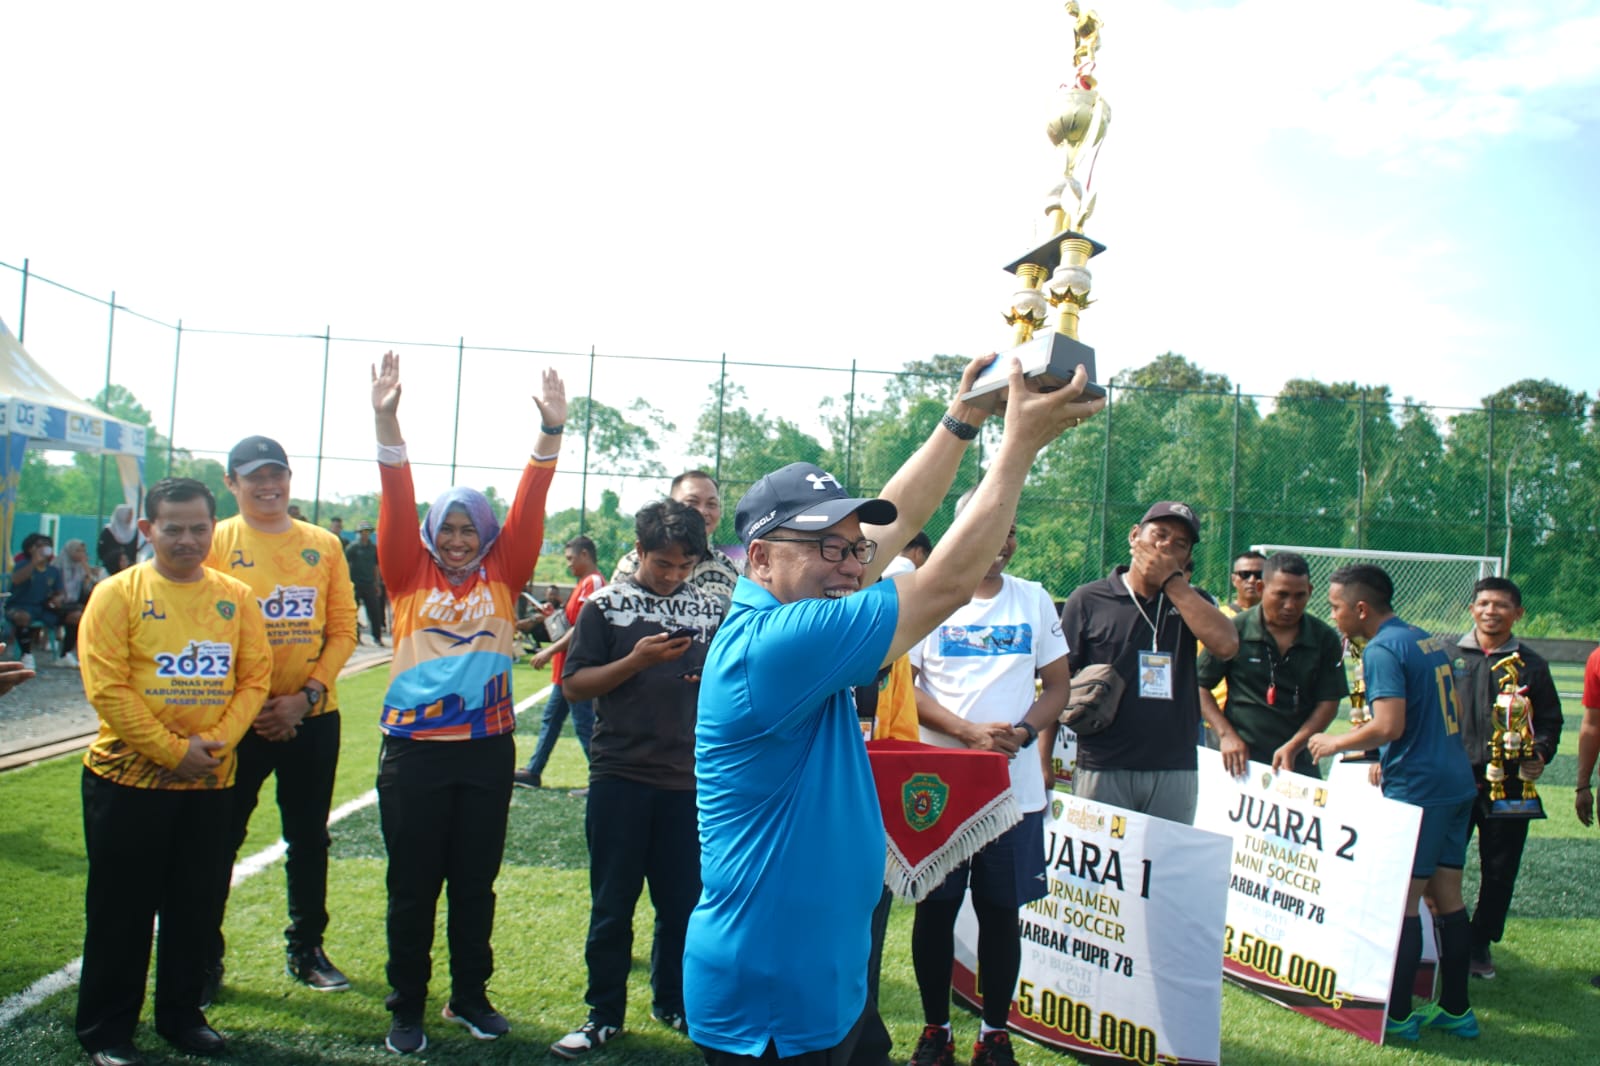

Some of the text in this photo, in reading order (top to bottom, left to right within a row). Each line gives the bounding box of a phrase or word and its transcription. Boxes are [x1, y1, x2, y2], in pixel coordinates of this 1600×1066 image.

[156, 654, 231, 677] 2023
[145, 688, 205, 696] KABUPATEN
[1434, 663, 1460, 737] 13
[1228, 793, 1359, 862] JUARA 2
[1045, 831, 1153, 899] UARA 1
[1234, 851, 1322, 895] MINI SOCCER
[1244, 835, 1319, 873] TURNAMEN
[1047, 877, 1121, 918] URNAMEN
[1229, 873, 1326, 924] ARBAK PUPR 78
[1026, 899, 1126, 944] MINI SOCCER
[1050, 956, 1092, 982] BUPATI
[1072, 937, 1110, 970] PUPR
[1113, 952, 1134, 977] 78
[1066, 978, 1091, 995] CUP
